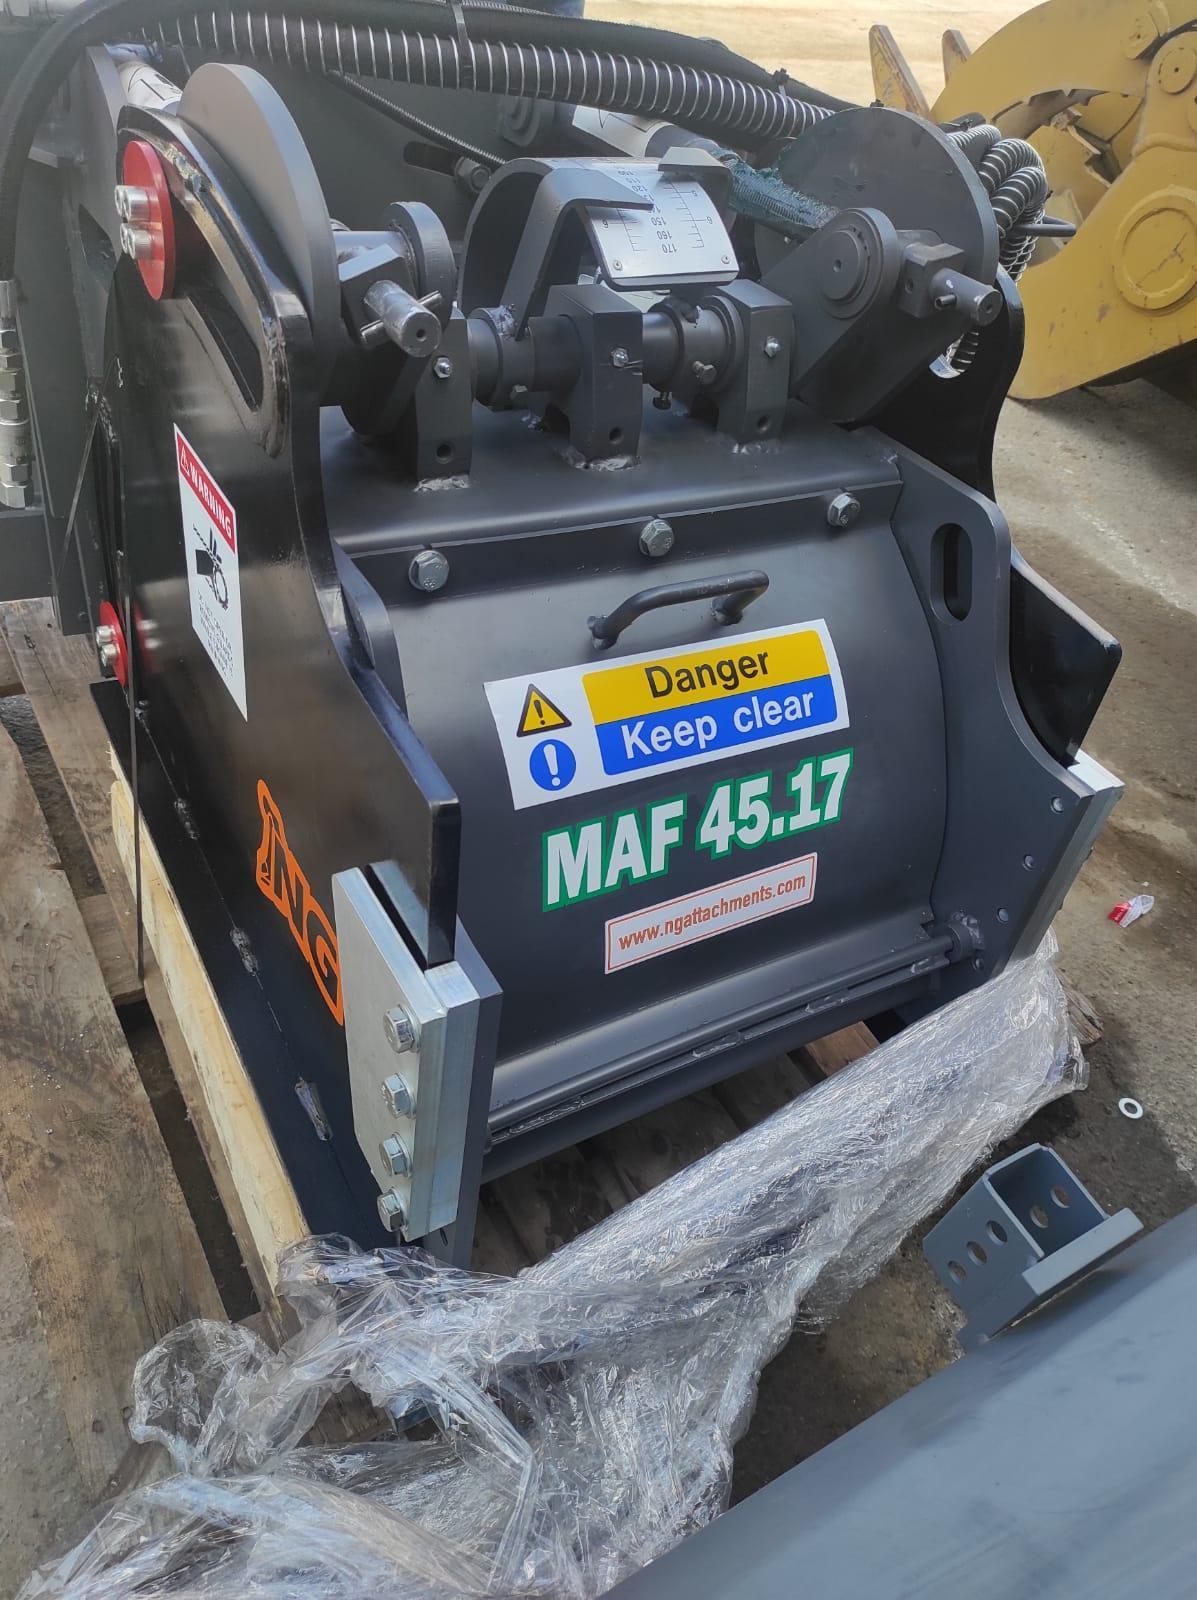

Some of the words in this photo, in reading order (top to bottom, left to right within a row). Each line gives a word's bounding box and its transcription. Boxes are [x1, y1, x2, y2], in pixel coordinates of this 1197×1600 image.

[650, 216, 667, 226] 150
[656, 230, 673, 240] 160
[661, 243, 678, 254] 170
[189, 461, 233, 540] WARNING
[644, 651, 769, 699] Danger
[620, 713, 718, 760] Keep
[732, 691, 815, 733] clear
[545, 797, 685, 907] MAF
[698, 751, 852, 856] 45.17
[617, 873, 807, 951] www.ngattachments.com
